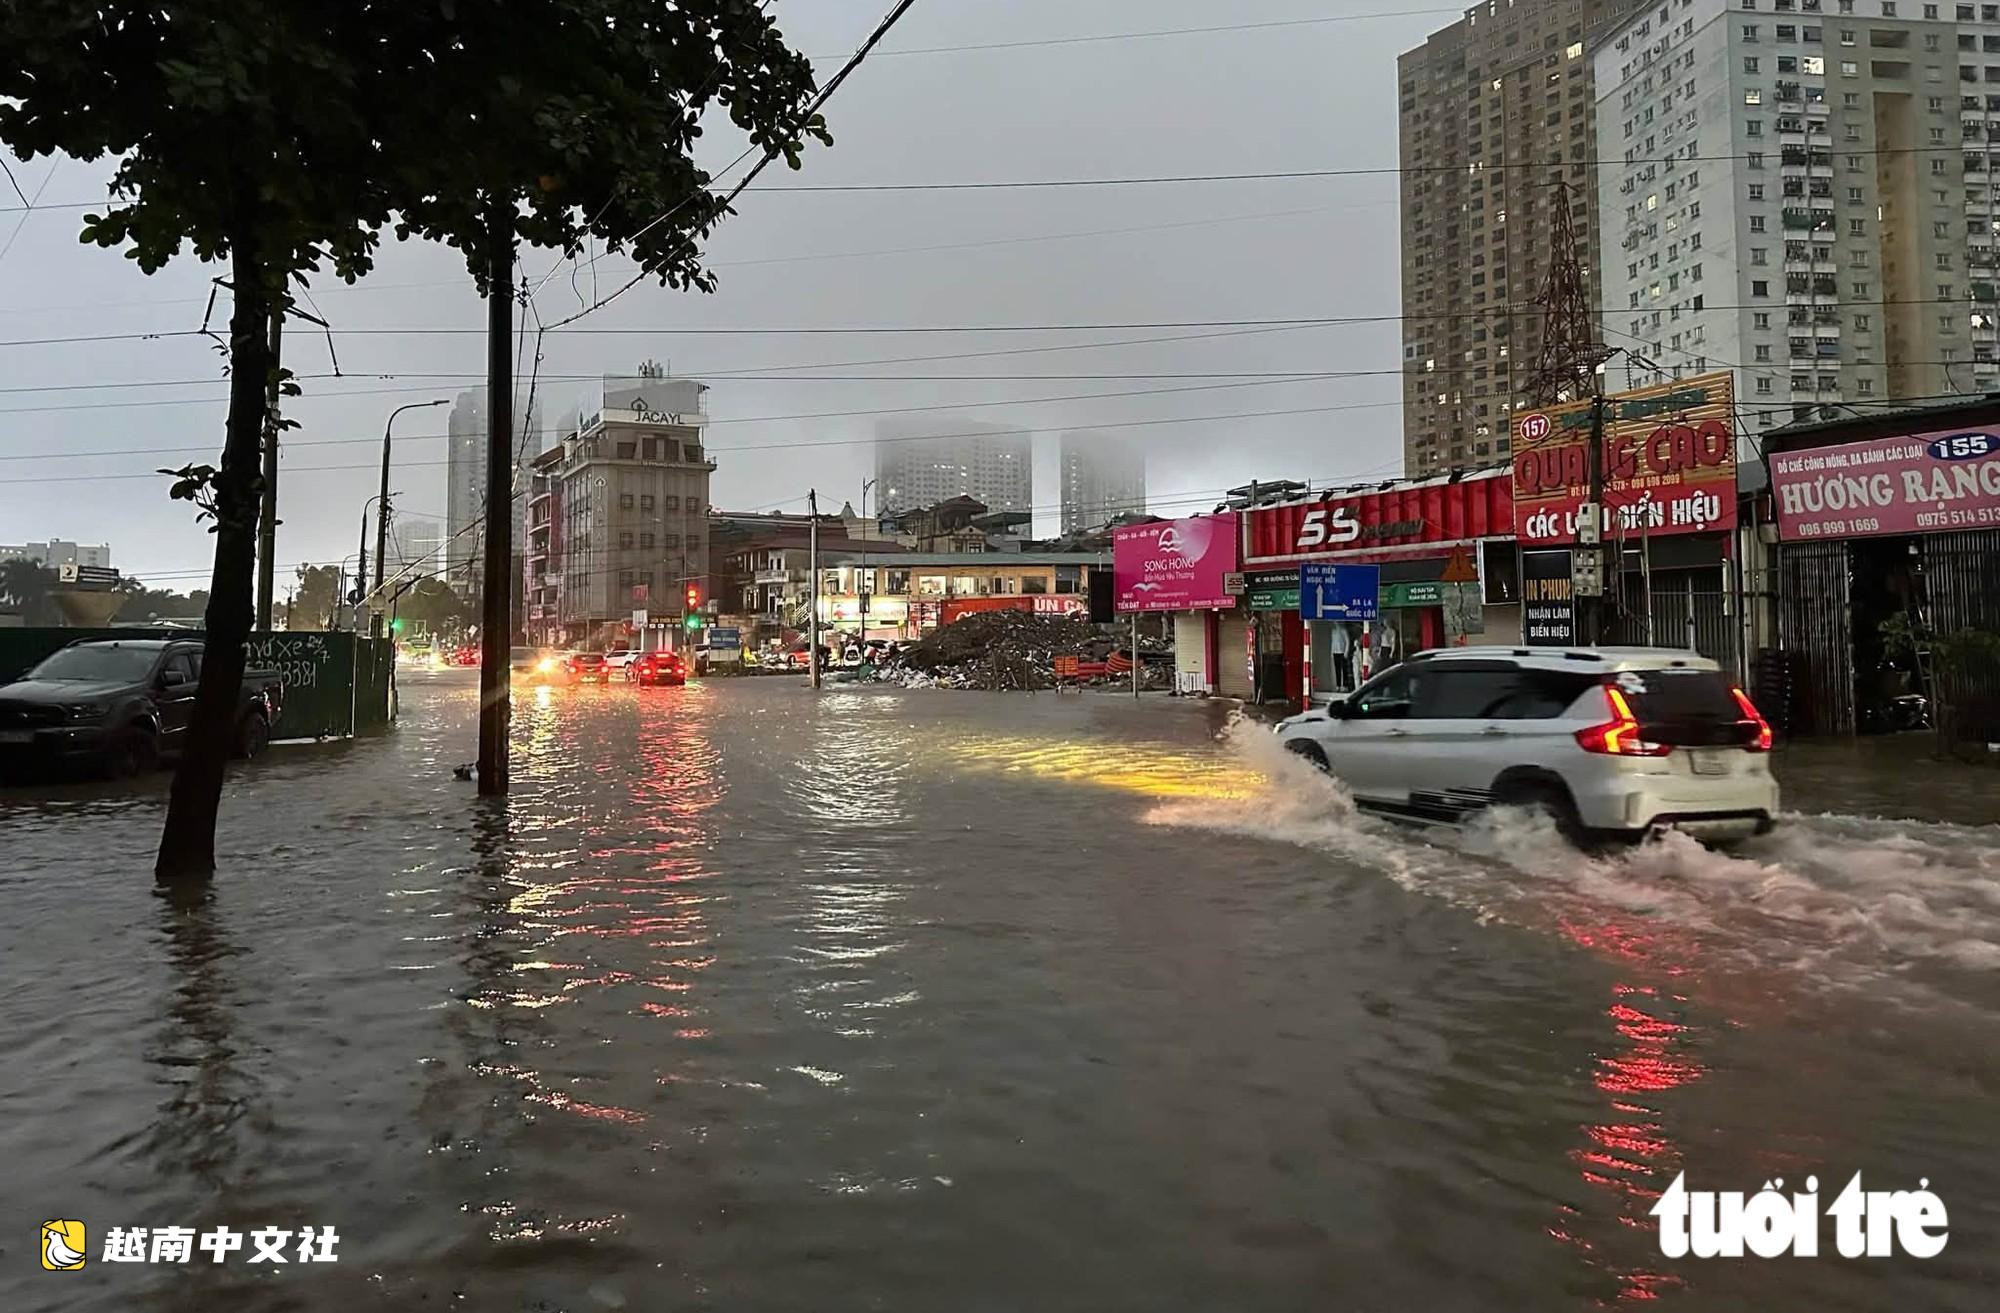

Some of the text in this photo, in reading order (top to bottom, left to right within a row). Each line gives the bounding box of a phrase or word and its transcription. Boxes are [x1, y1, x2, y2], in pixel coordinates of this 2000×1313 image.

[634, 410, 685, 425] JACAYL
[1523, 419, 1546, 437] 157
[1850, 452, 1862, 465] BA
[1863, 449, 1884, 464] BÁNH
[1886, 445, 1903, 461] CÁC
[1904, 444, 1923, 461] LOẠI
[1935, 435, 1988, 458] 155
[1780, 461, 2000, 515] HƯƠNG RẠNG
[1526, 506, 1559, 538] CÁC
[1672, 489, 1721, 531] HIỆU
[1916, 511, 1948, 526] 0975
[1951, 509, 1975, 525] 514
[1823, 520, 1845, 535] 999
[1849, 517, 1879, 533] 1669
[1525, 578, 1571, 601] IN PHUN
[1528, 606, 1551, 622] NHẬN
[1551, 624, 1570, 640] HIỆU
[276, 639, 303, 659] xe
